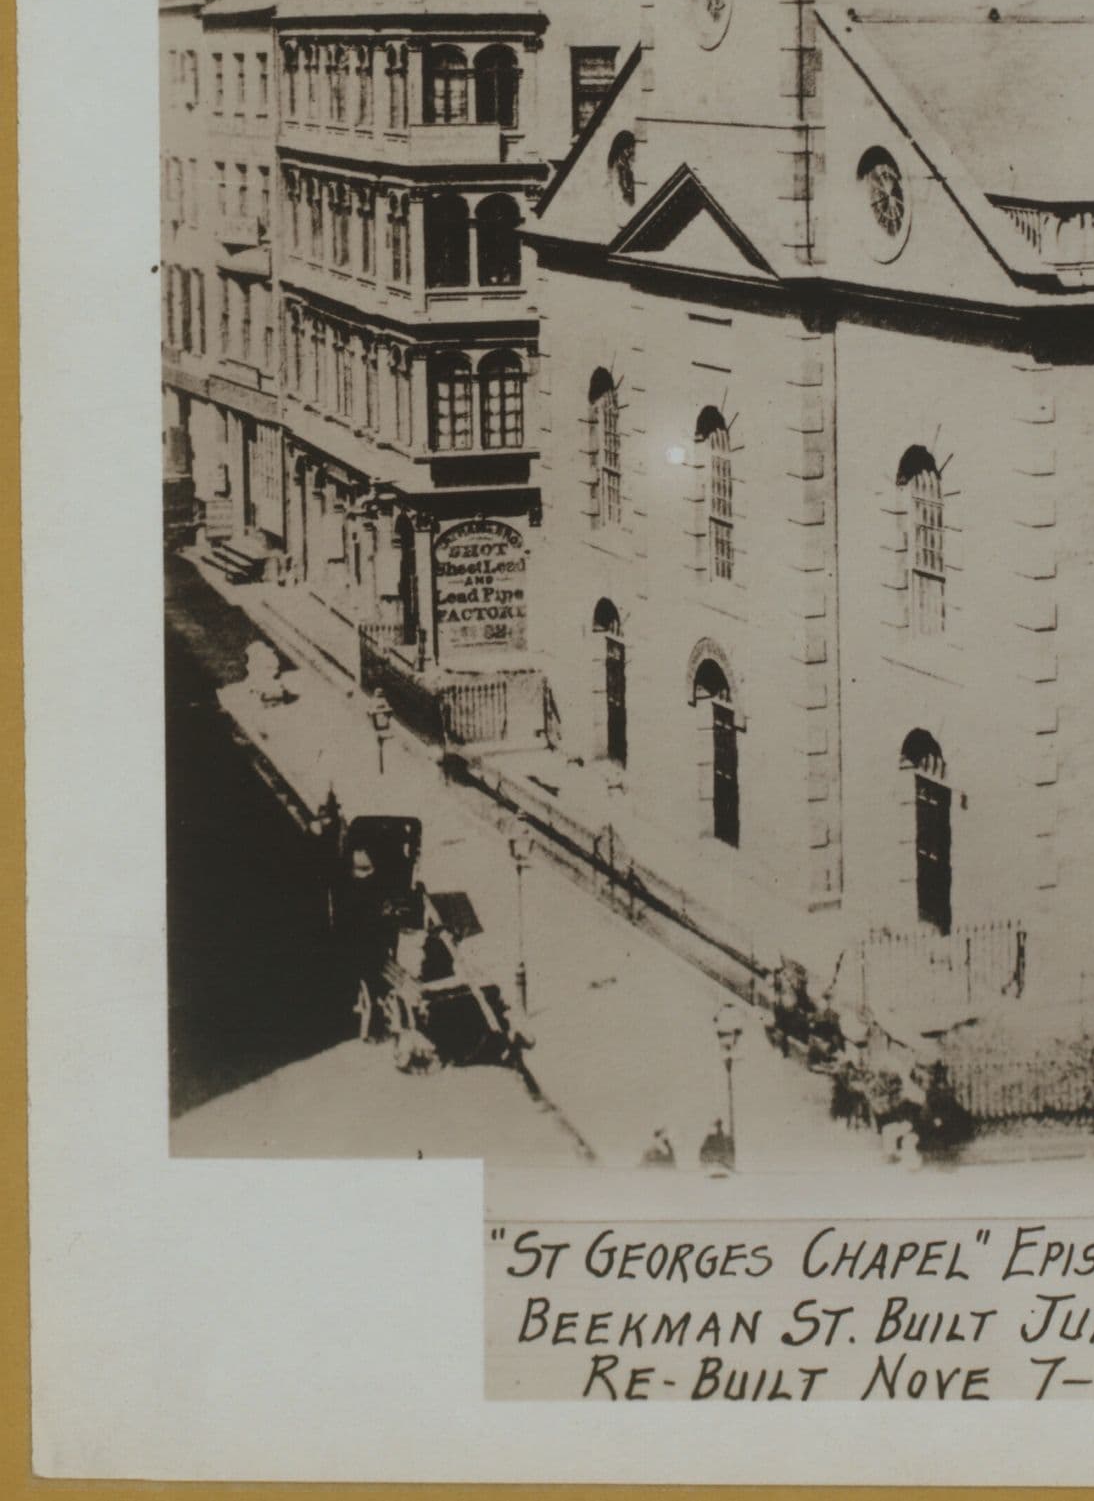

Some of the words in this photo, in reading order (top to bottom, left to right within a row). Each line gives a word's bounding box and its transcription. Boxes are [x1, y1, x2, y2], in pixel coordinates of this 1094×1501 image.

[448, 543, 509, 559] SHOT
[464, 575, 494, 586] AND
[436, 587, 480, 605] Lead
[482, 587, 525, 604] Pipe
